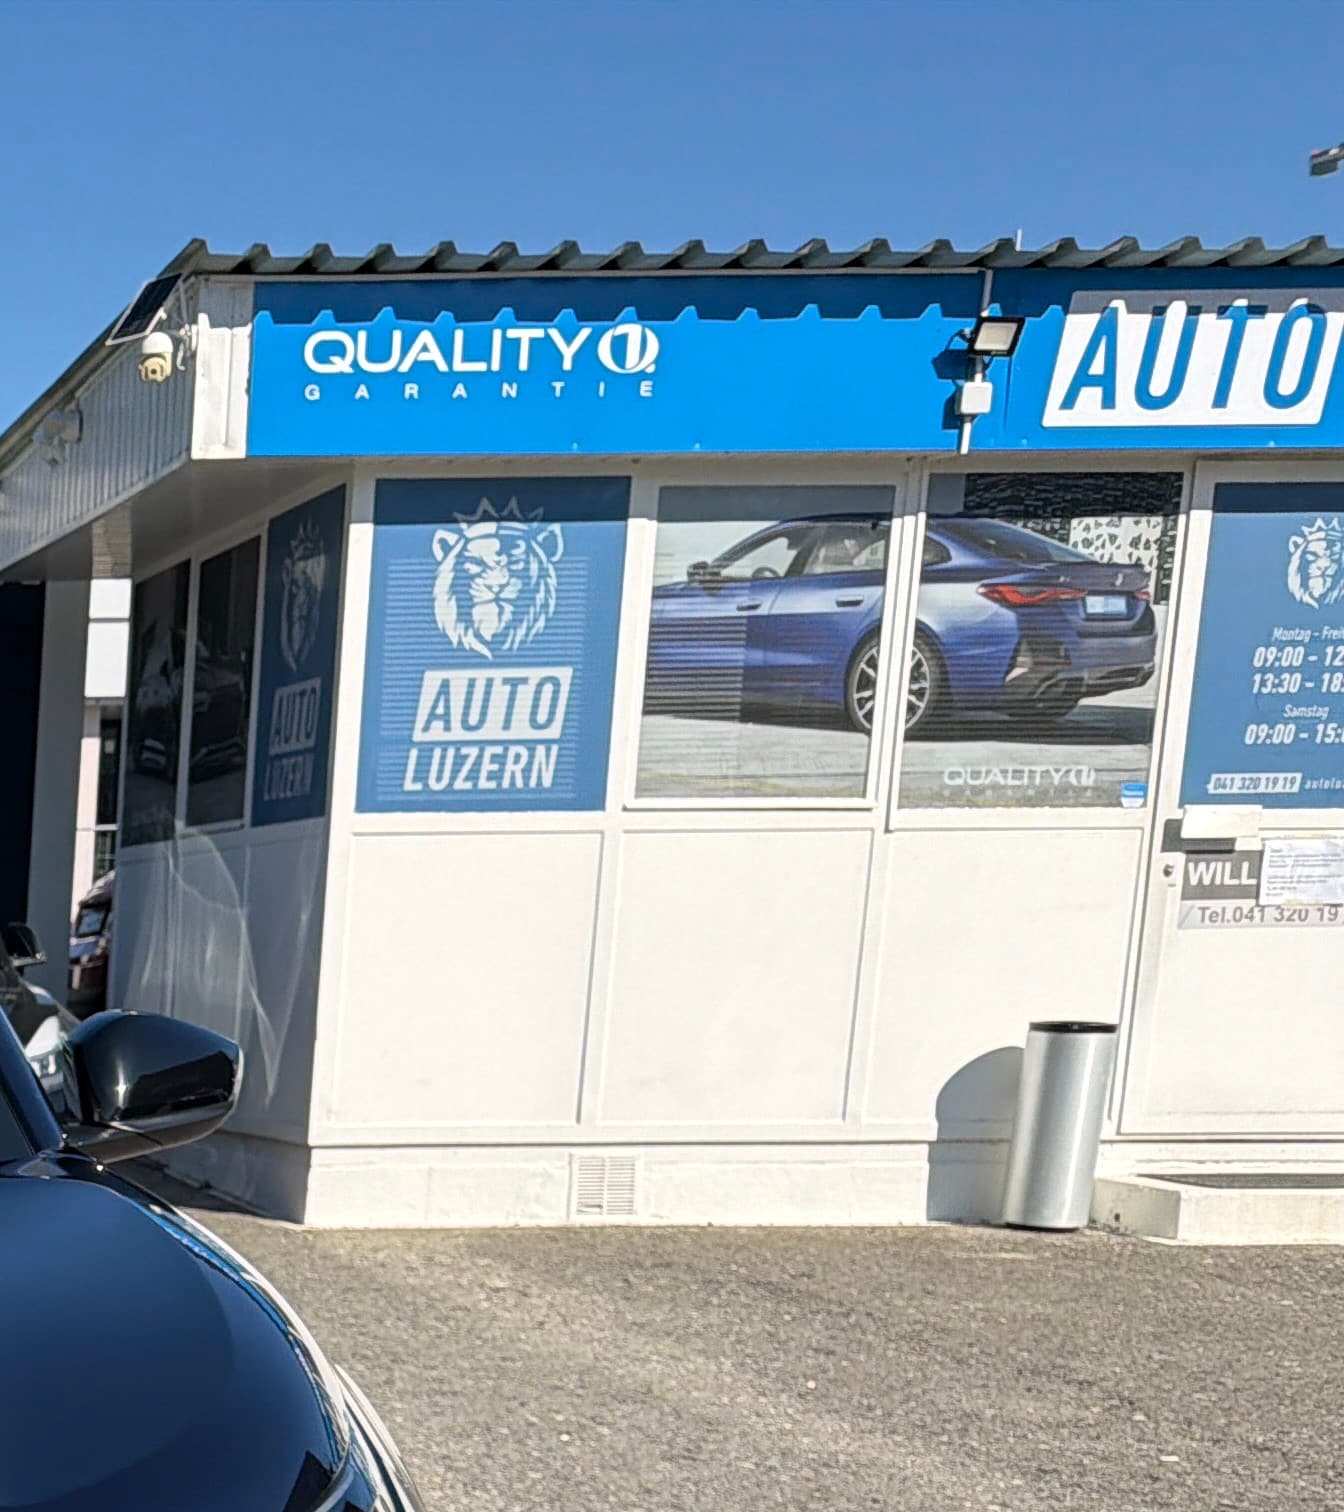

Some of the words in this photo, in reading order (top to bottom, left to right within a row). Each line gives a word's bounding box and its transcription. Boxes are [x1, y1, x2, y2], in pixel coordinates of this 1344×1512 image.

[1058, 303, 1328, 411] AUTO
[304, 380, 654, 401] GARANTIE
[1272, 627, 1311, 642] Montag
[1253, 646, 1304, 668] 09:00
[1252, 672, 1301, 694] 13:30
[421, 675, 561, 733] AUTO
[1284, 704, 1329, 720] Samstag
[271, 686, 317, 745] AUTO
[1244, 724, 1296, 745] 09:00
[403, 744, 559, 791] LUZERN
[1213, 777, 1235, 790] 041
[1238, 777, 1262, 790] 320
[1264, 776, 1279, 790] 19
[1282, 776, 1298, 789] 19
[1274, 906, 1309, 922] 320
[1316, 906, 1339, 922] 19
